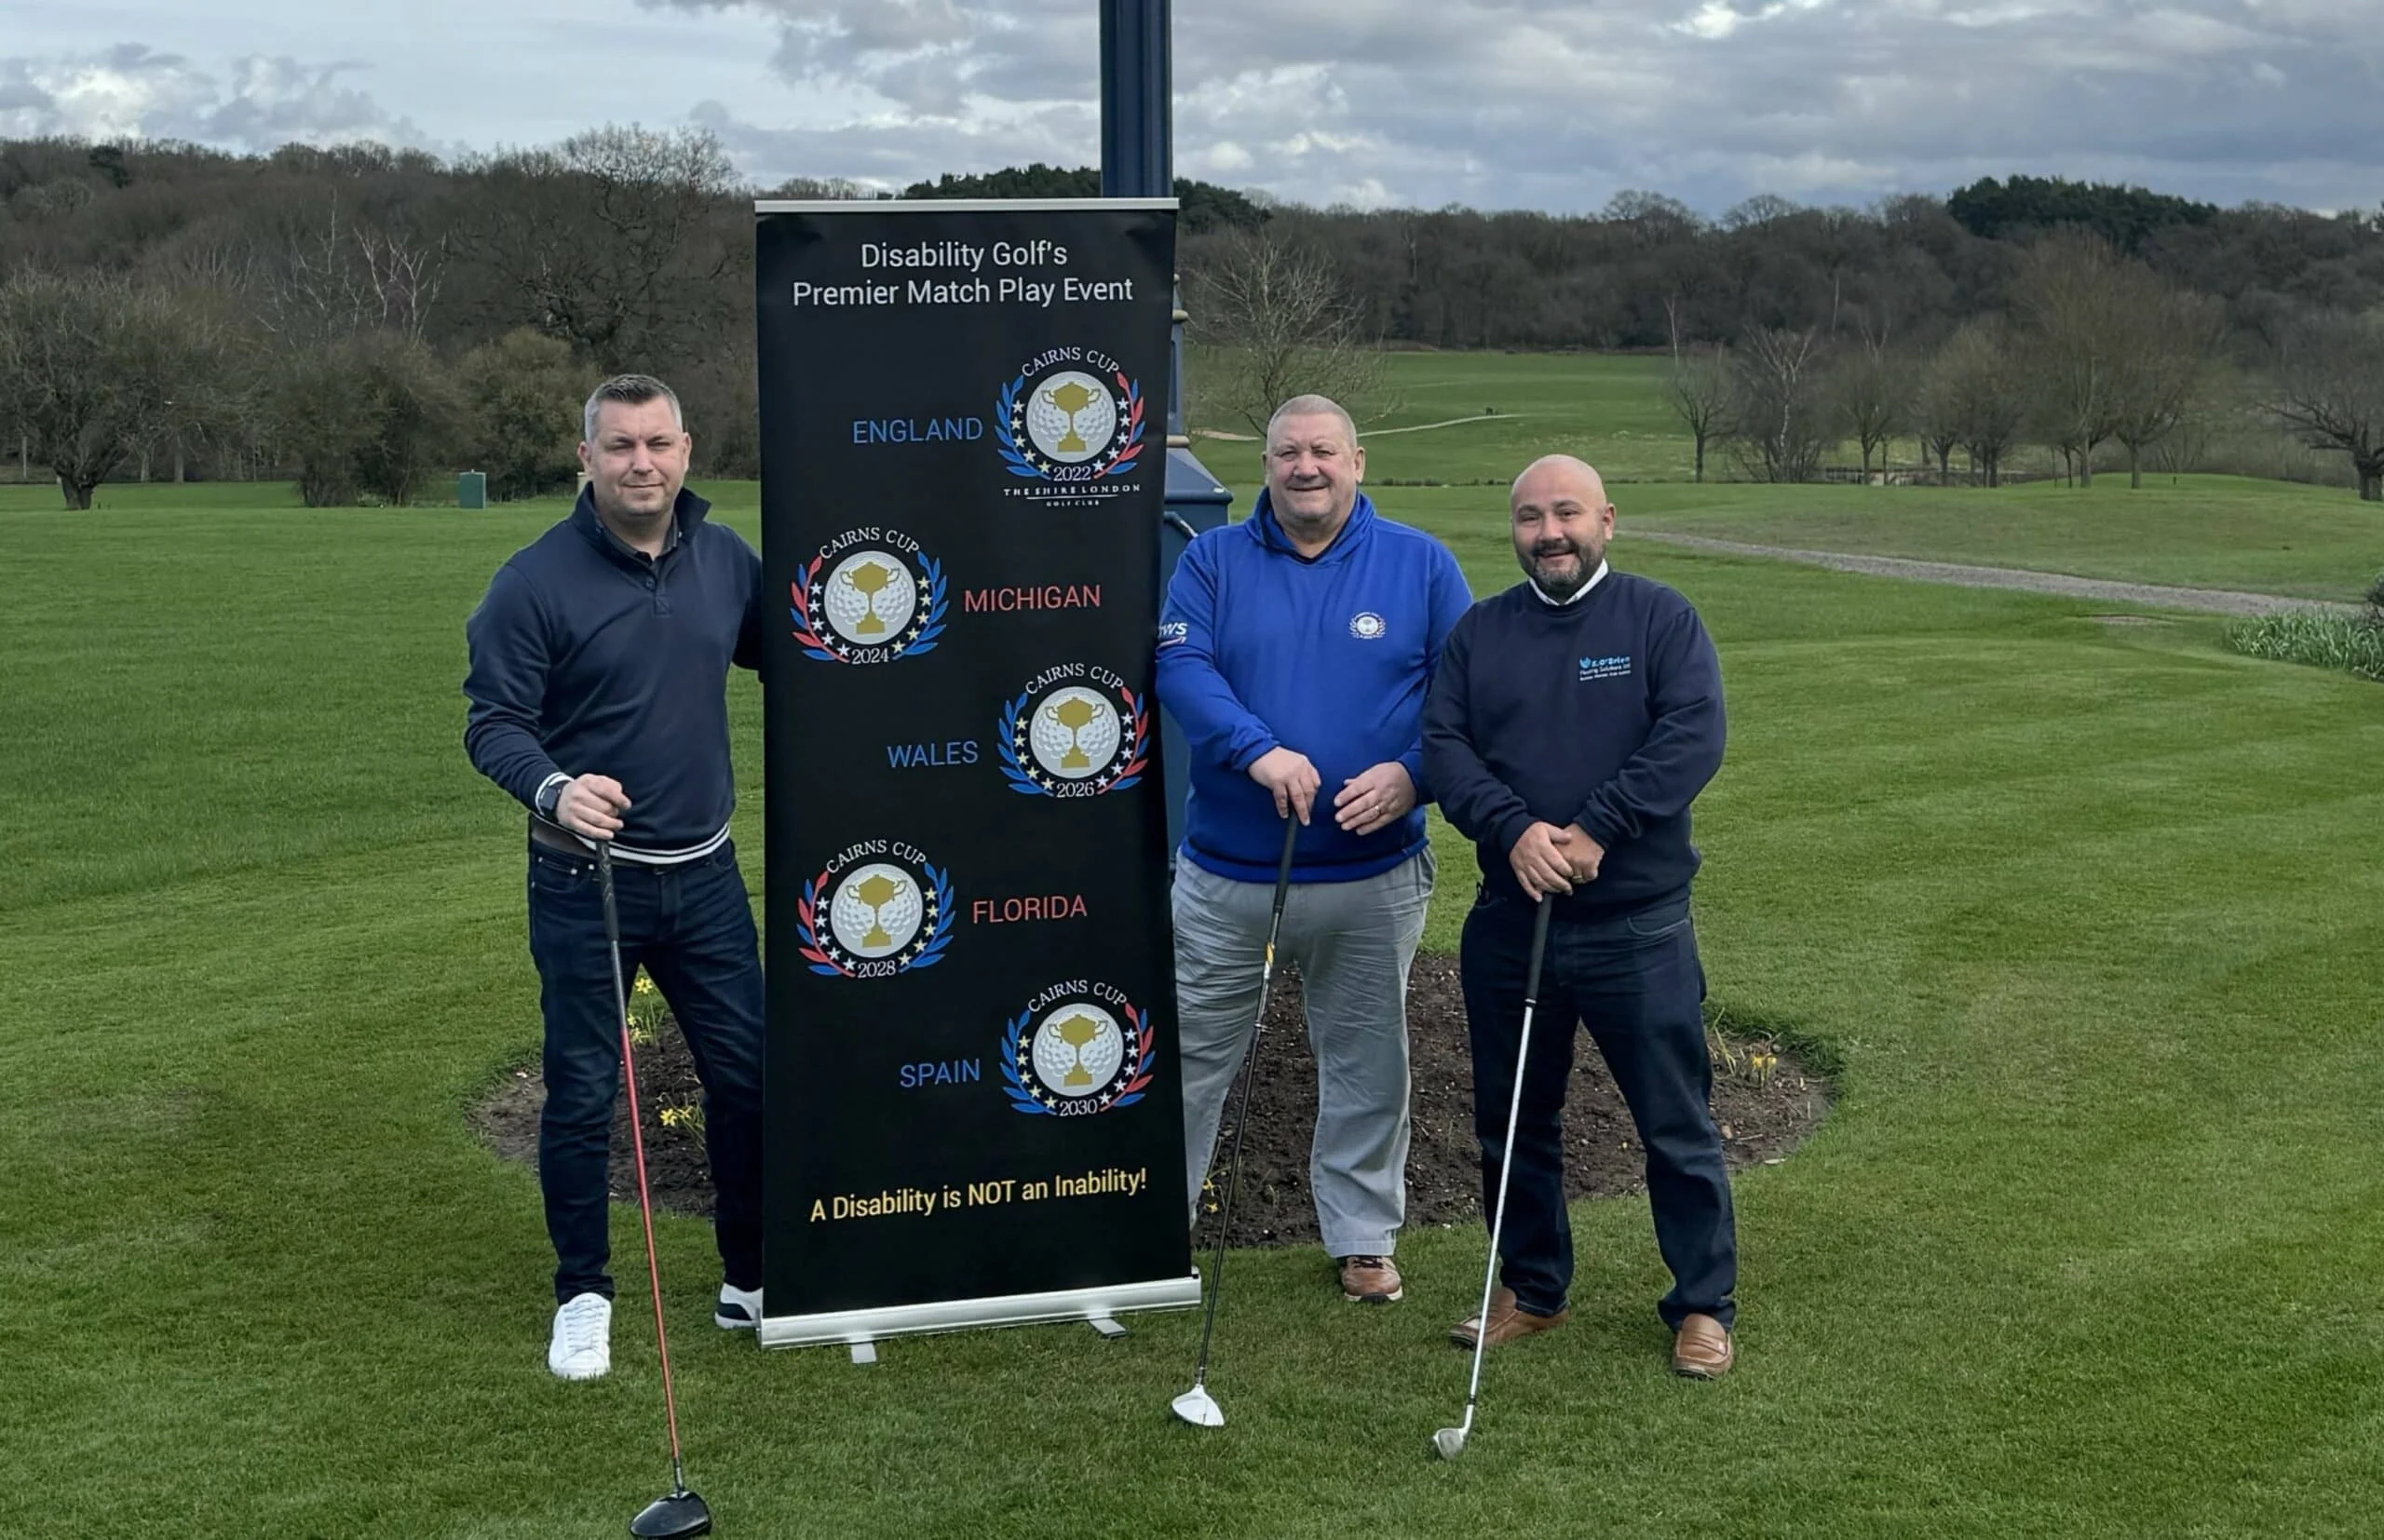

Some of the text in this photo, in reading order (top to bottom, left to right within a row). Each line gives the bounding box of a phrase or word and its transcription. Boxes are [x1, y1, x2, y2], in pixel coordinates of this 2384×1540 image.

[861, 241, 1068, 272] Disability Golf's
[793, 277, 1132, 307] Premier Match Play Event
[1022, 346, 1119, 376] CAIRNS CUP
[853, 418, 982, 444] ENGLAND
[1053, 466, 1091, 481] 2022
[1003, 484, 1140, 496] THE SHIRE LONDON
[819, 528, 920, 560] CAIRNS CUP
[964, 585, 1101, 612] MICHIGAN
[851, 648, 889, 665] 2024
[1026, 664, 1124, 695] CAIRNS CUP
[887, 741, 978, 768] WALES
[1056, 781, 1094, 797] 2026
[826, 840, 927, 874] CAIRNS CUP
[973, 895, 1087, 924] FLORIDA
[858, 961, 896, 978] 2028
[1028, 980, 1128, 1012] CAIRNS CUP
[900, 1059, 981, 1087] SPAIN
[1060, 1099, 1098, 1115] 2030
[810, 1168, 1146, 1222] A Disability is NOT an Inability!
